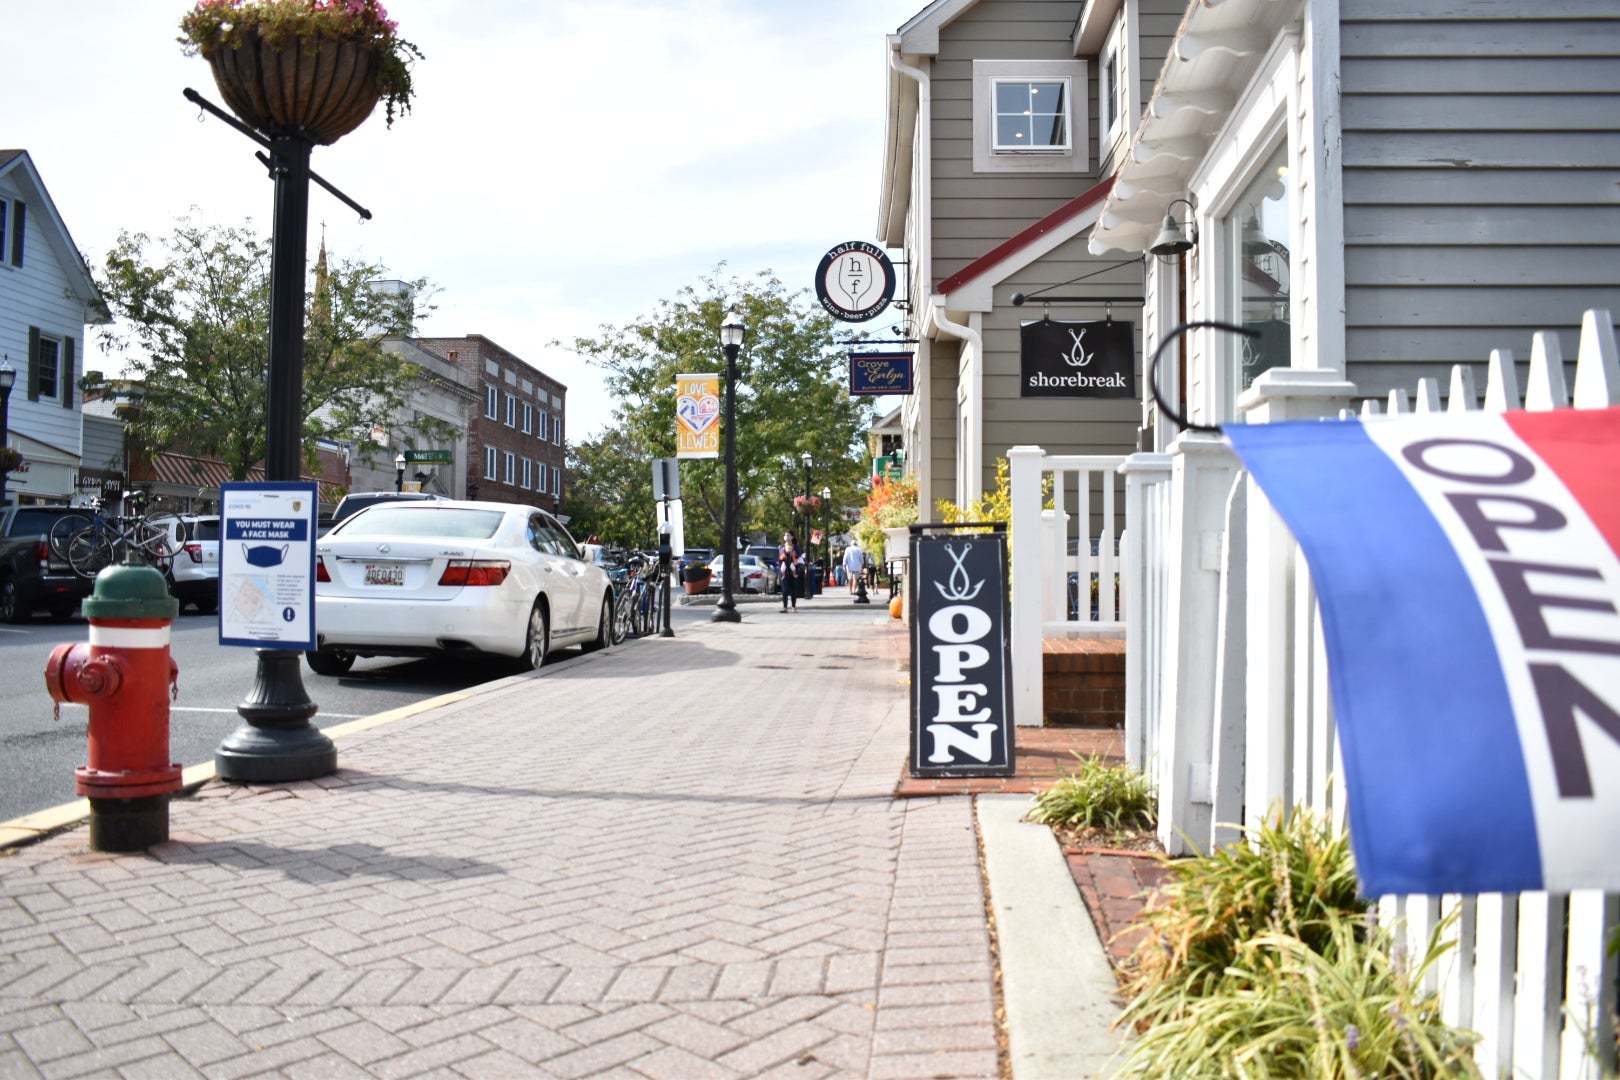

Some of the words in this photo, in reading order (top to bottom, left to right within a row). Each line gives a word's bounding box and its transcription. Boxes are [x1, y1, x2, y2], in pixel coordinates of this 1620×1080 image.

[828, 242, 855, 260] half
[860, 243, 884, 260] full
[849, 257, 862, 272] h
[851, 279, 861, 294] f
[823, 297, 840, 315] wine
[844, 311, 864, 319] beer
[868, 297, 887, 316] pizza
[1029, 371, 1127, 388] shorebreak
[684, 383, 706, 394] LOVE
[680, 431, 717, 449] LEWES
[926, 605, 998, 763] OPEN
